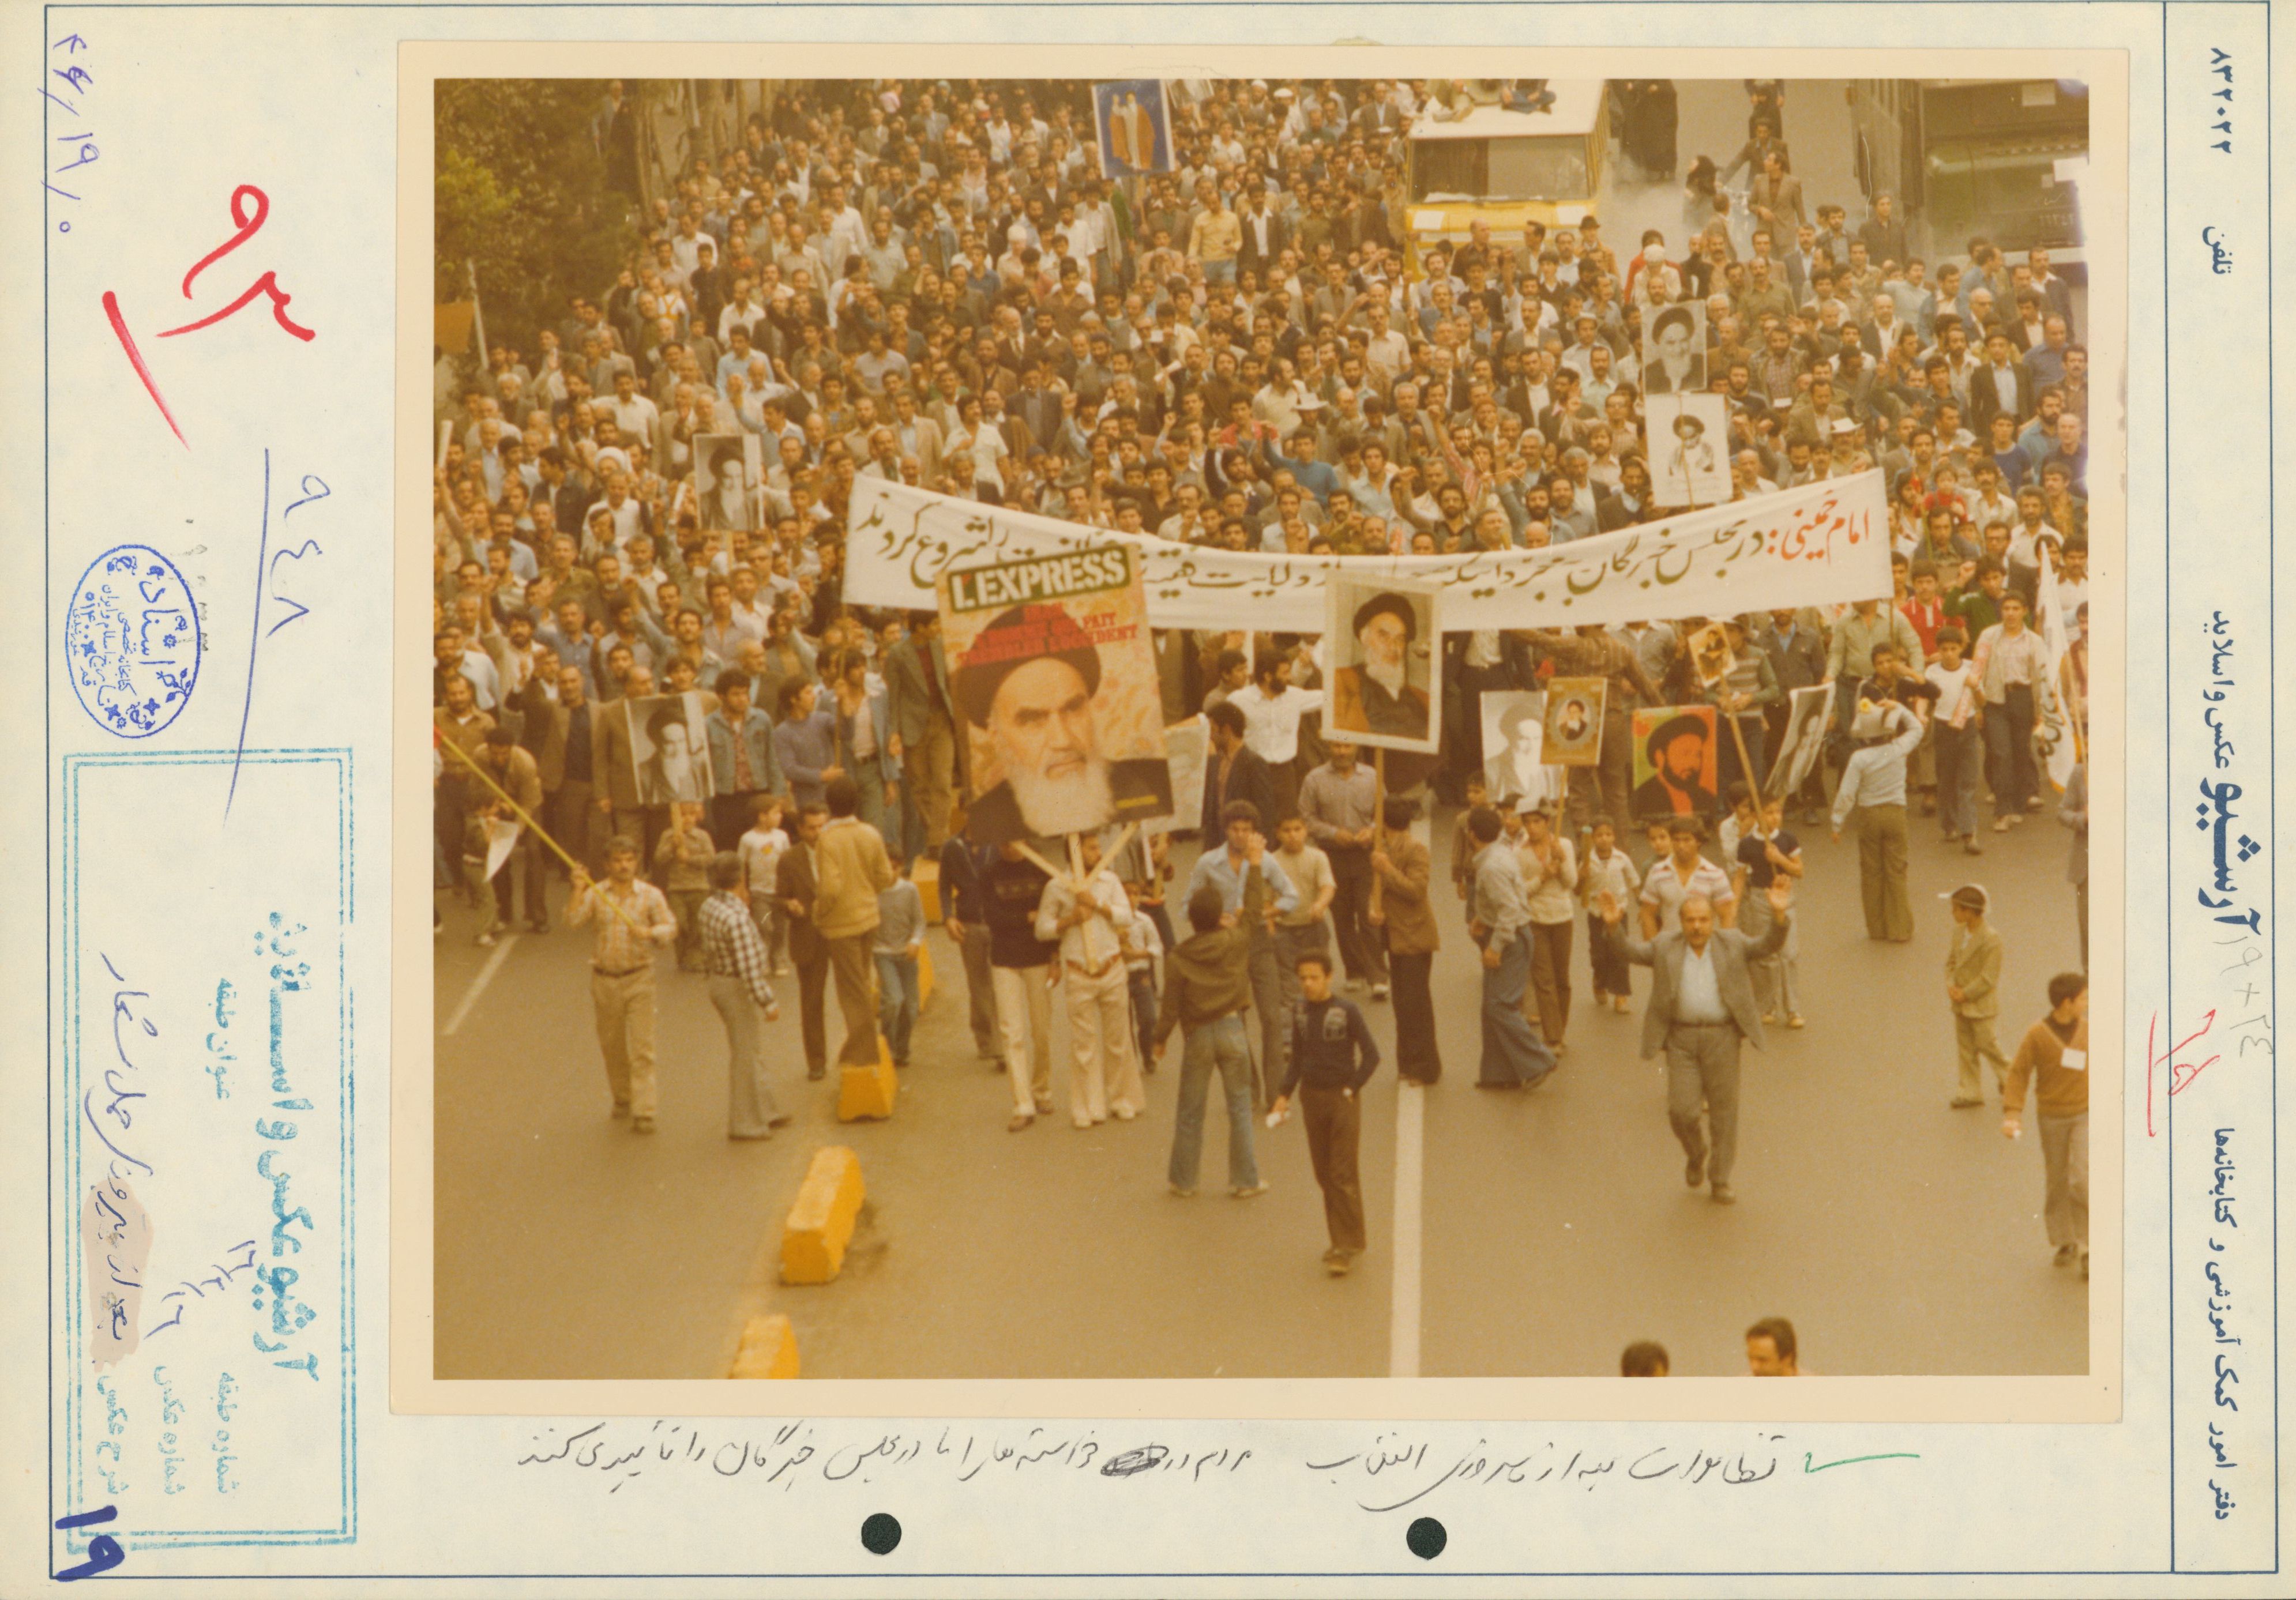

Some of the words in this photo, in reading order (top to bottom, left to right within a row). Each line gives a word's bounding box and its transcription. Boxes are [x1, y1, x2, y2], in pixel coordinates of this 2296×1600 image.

[2209, 47, 2234, 155] ۸۳۲۰۲۲
[2201, 225, 2233, 275] تلفن
[856, 491, 943, 560] کردند
[1654, 519, 1748, 586] مجلس
[1726, 530, 1765, 562] در
[1826, 507, 1870, 566] امام
[952, 548, 1129, 611] L'EXPRESS
[1566, 527, 1678, 596] خبرگان
[116, 612, 136, 655] تخصصی
[114, 655, 136, 697] کتابخانه
[2204, 707, 2235, 770] عکس
[2195, 777, 2262, 936] آرشیو
[208, 978, 237, 1029] طبقه
[205, 1031, 237, 1100] عنوان
[257, 1150, 314, 1258] عکس
[2208, 1237, 2226, 1252] و
[250, 1266, 320, 1381] آرشیو
[2204, 1260, 2242, 1346] آموزشی
[96, 1375, 128, 1436] عکس
[153, 1365, 186, 1425] عکس
[210, 1372, 239, 1422] طبقه
[2214, 1353, 2240, 1413] کمک
[96, 1441, 130, 1495] شرح
[157, 1432, 186, 1495] شماره
[211, 1429, 240, 1494] شماره
[2208, 1421, 2238, 1469] امور
[2208, 1478, 2237, 1520] دفتر
